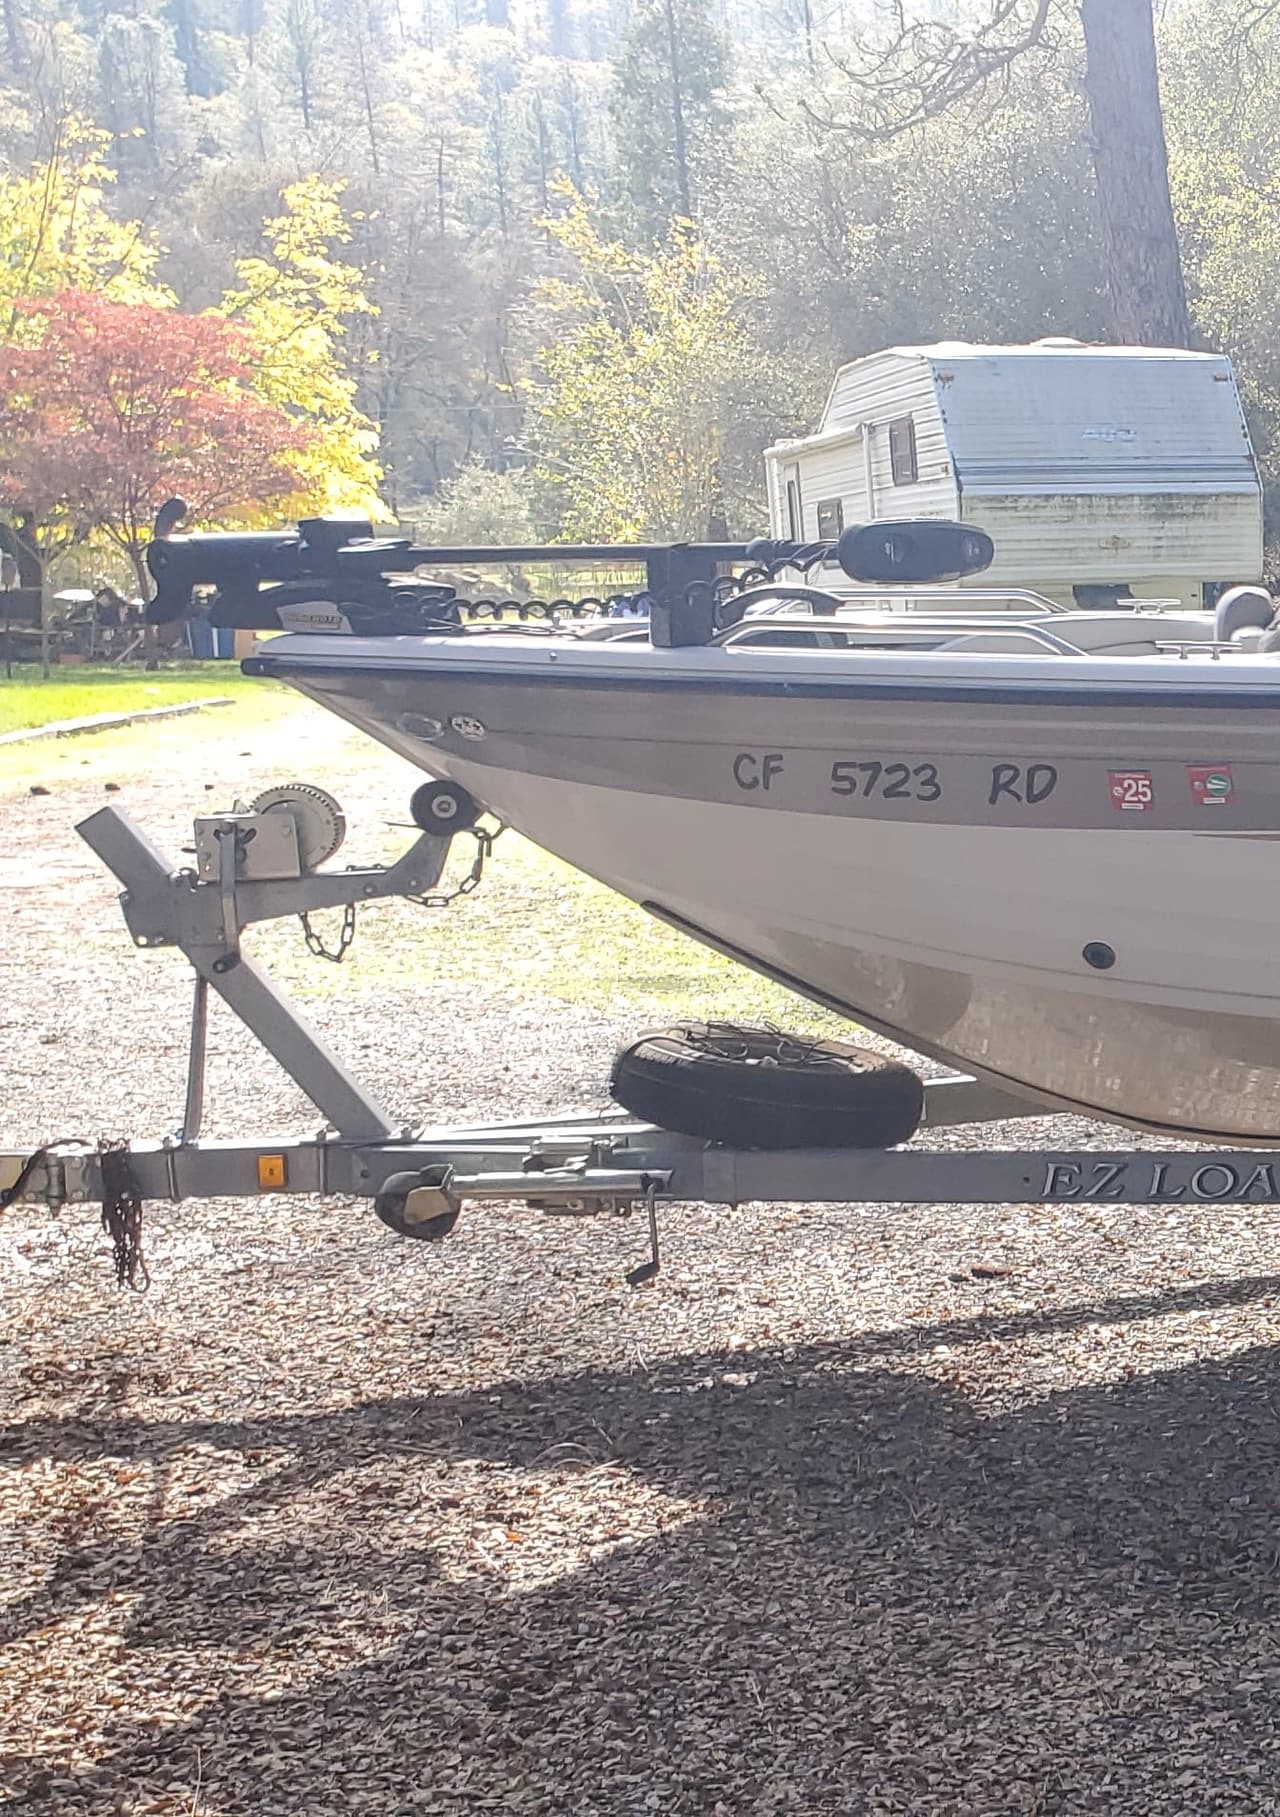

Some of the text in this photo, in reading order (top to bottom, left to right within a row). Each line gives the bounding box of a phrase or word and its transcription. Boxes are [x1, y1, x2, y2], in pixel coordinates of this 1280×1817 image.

[732, 753, 1058, 804] CF 5723 RD
[1123, 779, 1151, 802] 25
[1041, 1162, 1126, 1198] EZ
